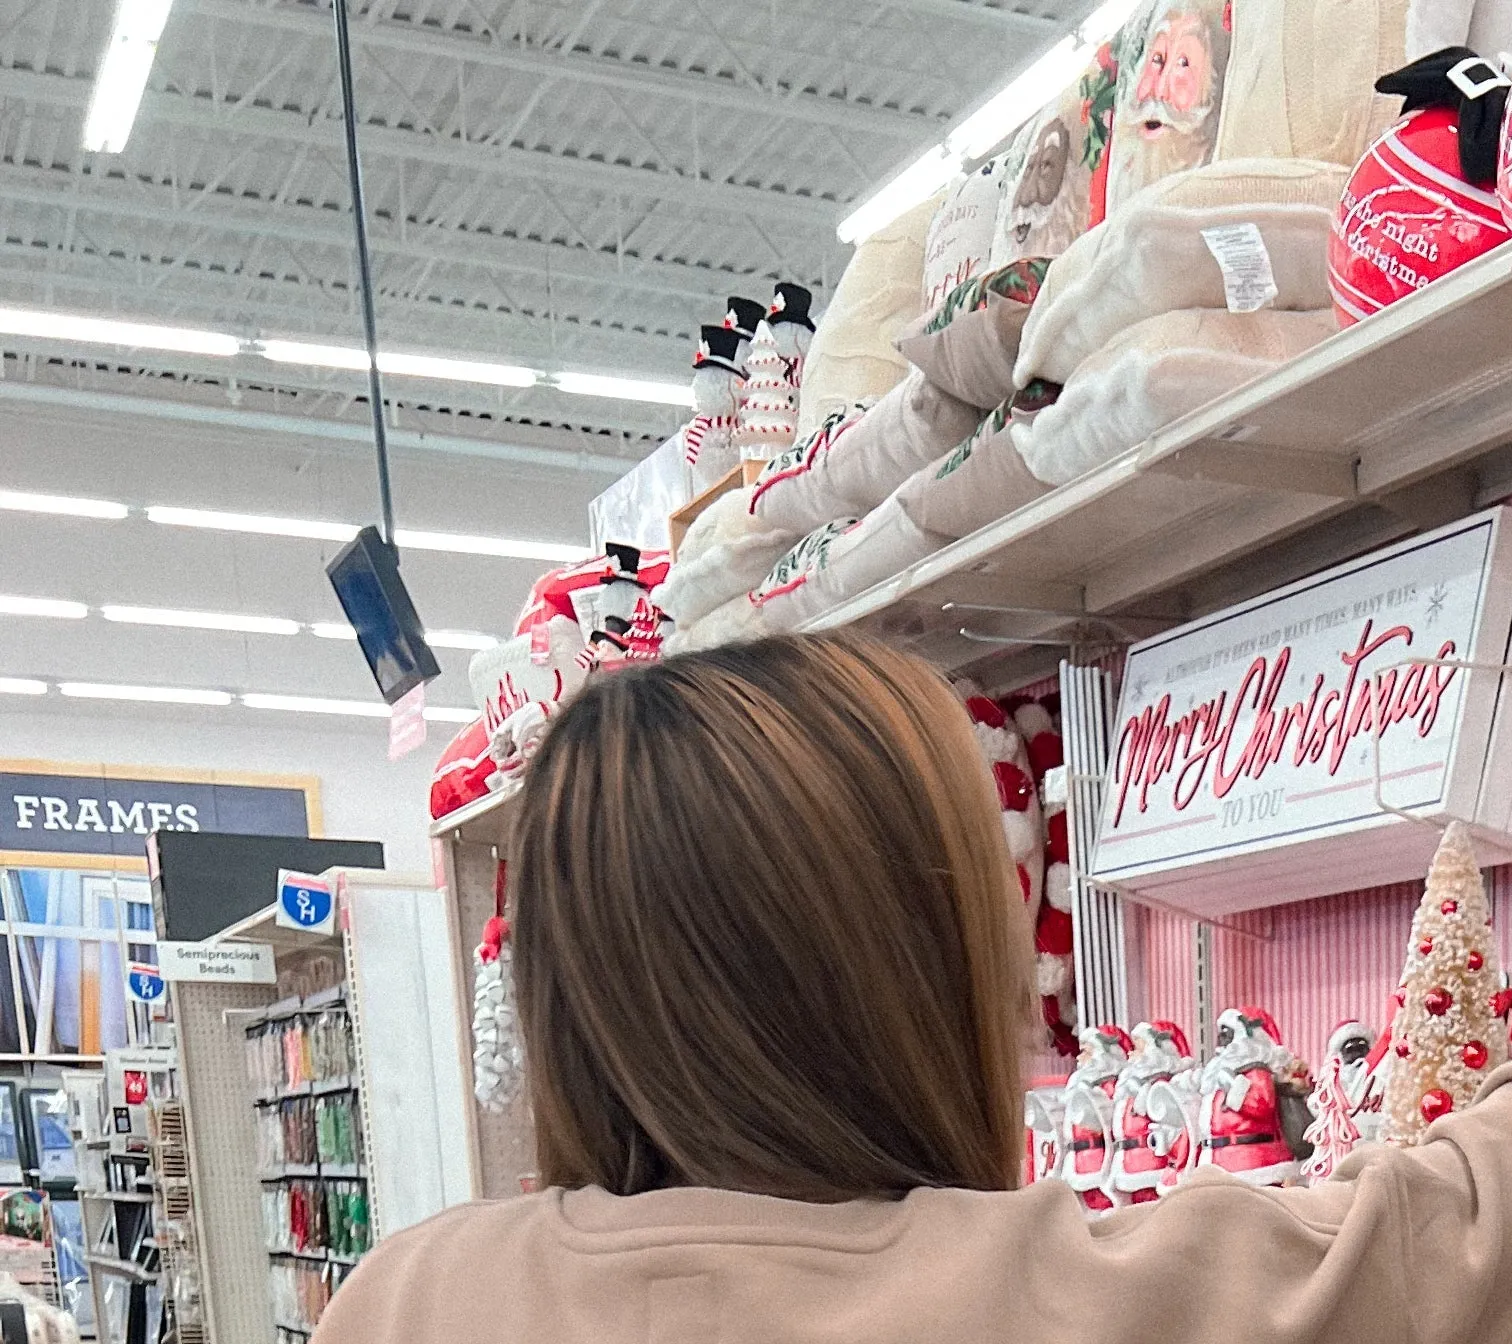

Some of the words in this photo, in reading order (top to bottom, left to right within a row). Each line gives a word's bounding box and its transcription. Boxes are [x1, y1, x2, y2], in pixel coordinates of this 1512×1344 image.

[1380, 220, 1439, 262] night
[1114, 691, 1227, 828] Merry
[1213, 619, 1457, 799] Christmas
[13, 795, 201, 834] FRAMES
[1221, 801, 1241, 829] TO
[1247, 787, 1286, 823] YOU
[176, 947, 260, 961] Semiprecious
[199, 963, 236, 974] Beads
